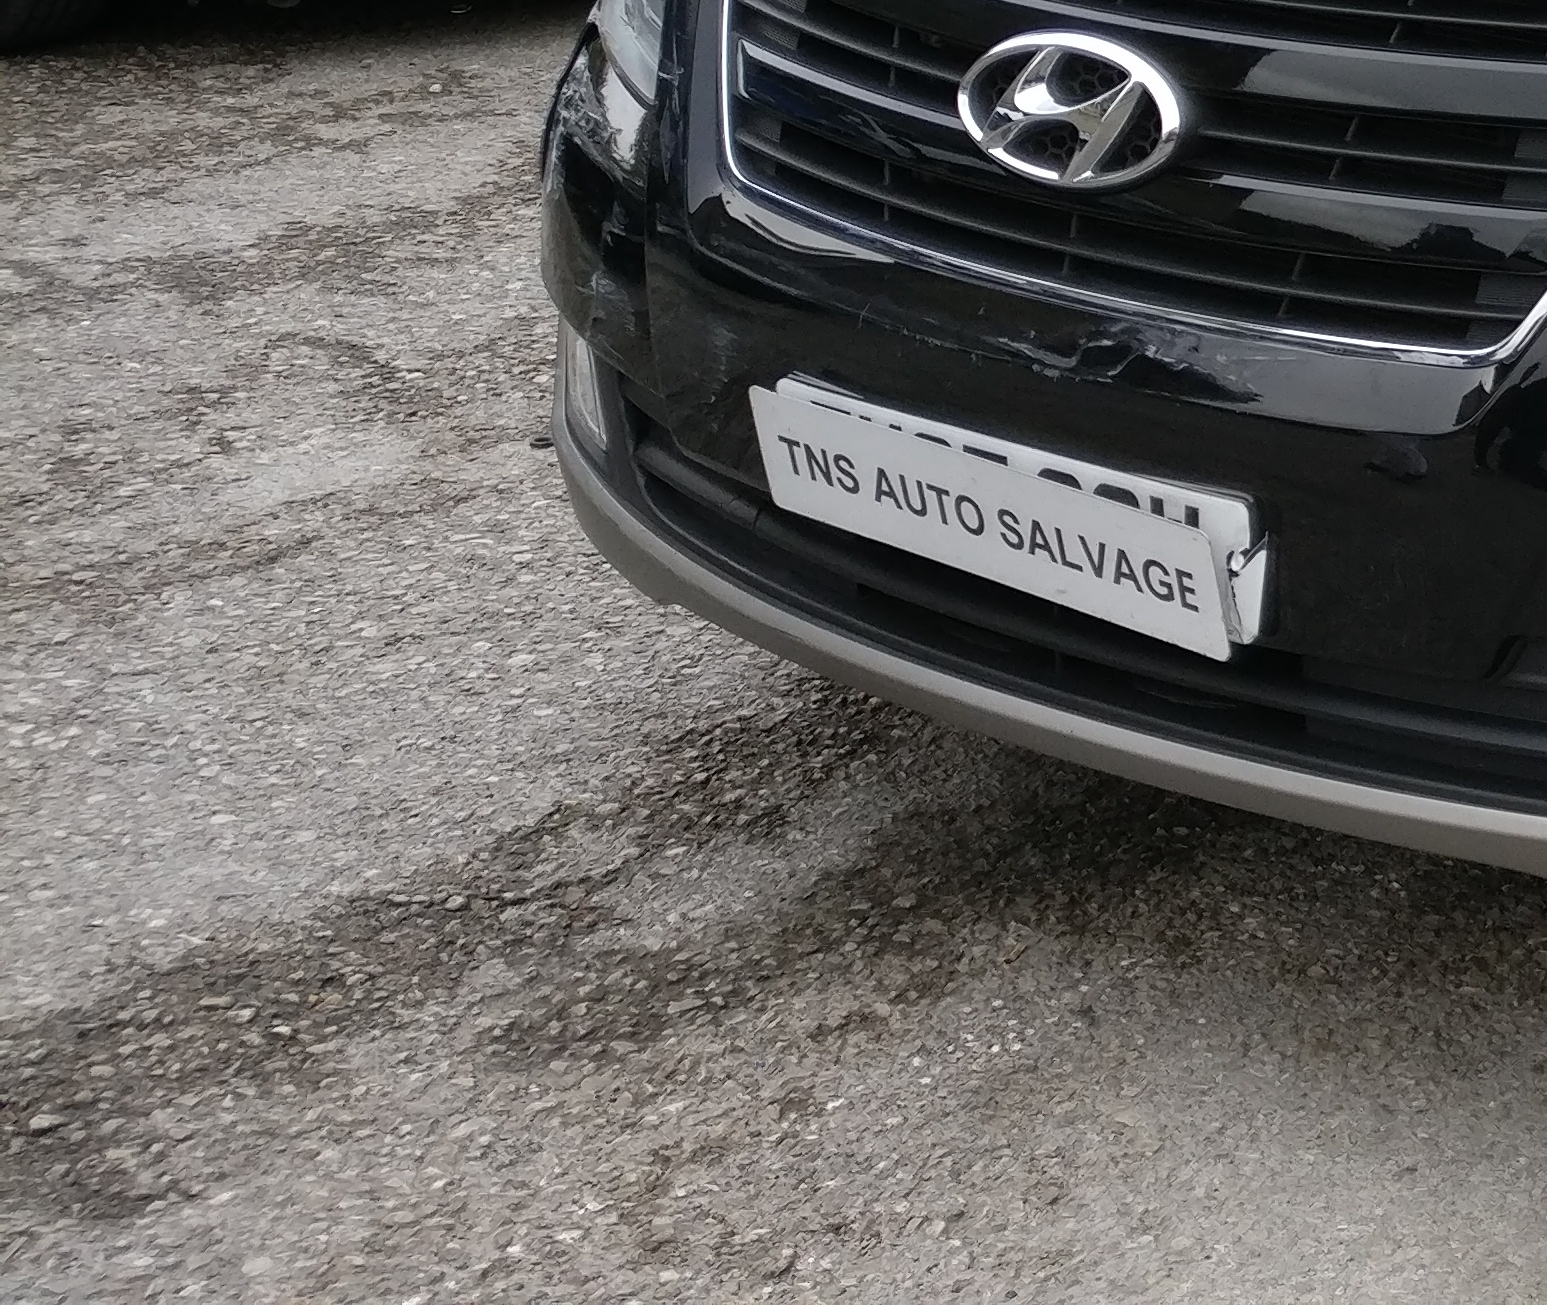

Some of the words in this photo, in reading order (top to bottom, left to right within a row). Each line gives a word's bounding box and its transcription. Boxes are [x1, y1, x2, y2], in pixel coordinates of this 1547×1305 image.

[777, 433, 860, 495] TNS
[873, 466, 986, 537] AUTO
[999, 507, 1201, 614] SALVAGE
